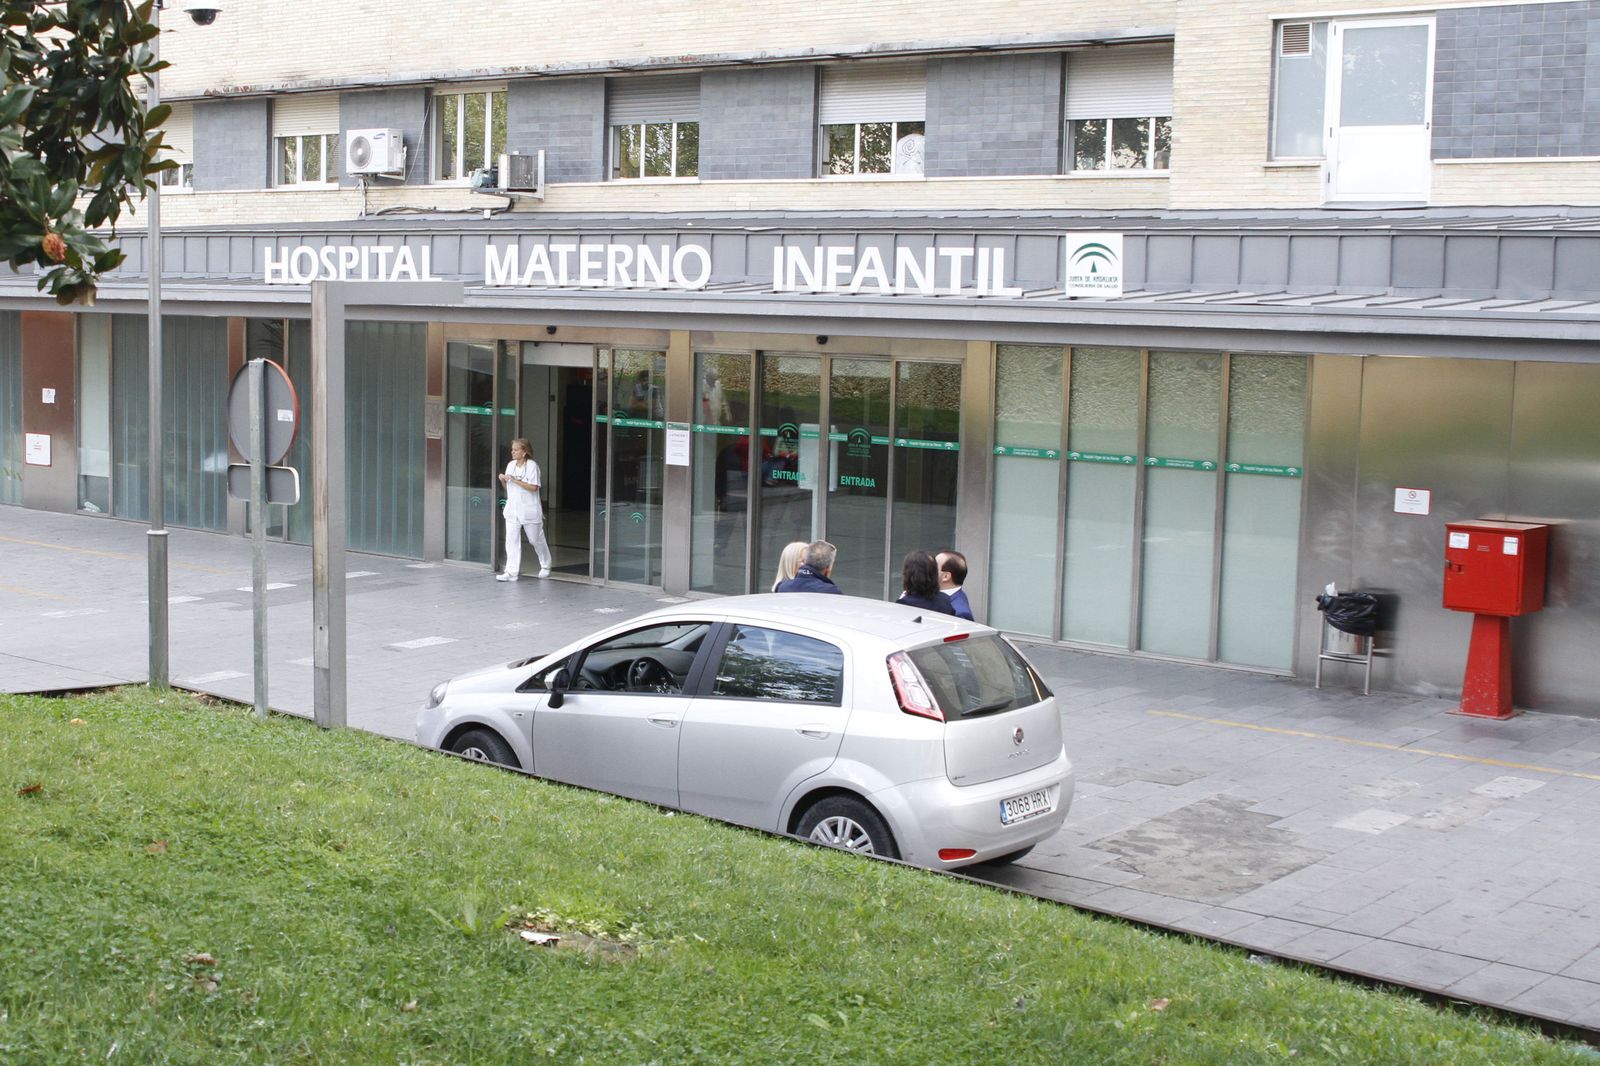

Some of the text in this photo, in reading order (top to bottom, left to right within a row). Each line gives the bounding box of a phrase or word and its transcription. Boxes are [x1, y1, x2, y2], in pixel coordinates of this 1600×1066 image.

[264, 243, 1023, 297] HOSPITAL MATERNO INFANTIL
[772, 470, 806, 481] ENTRADA
[840, 475, 876, 488] ENTRADA
[1006, 791, 1049, 817] 3068 HRX
